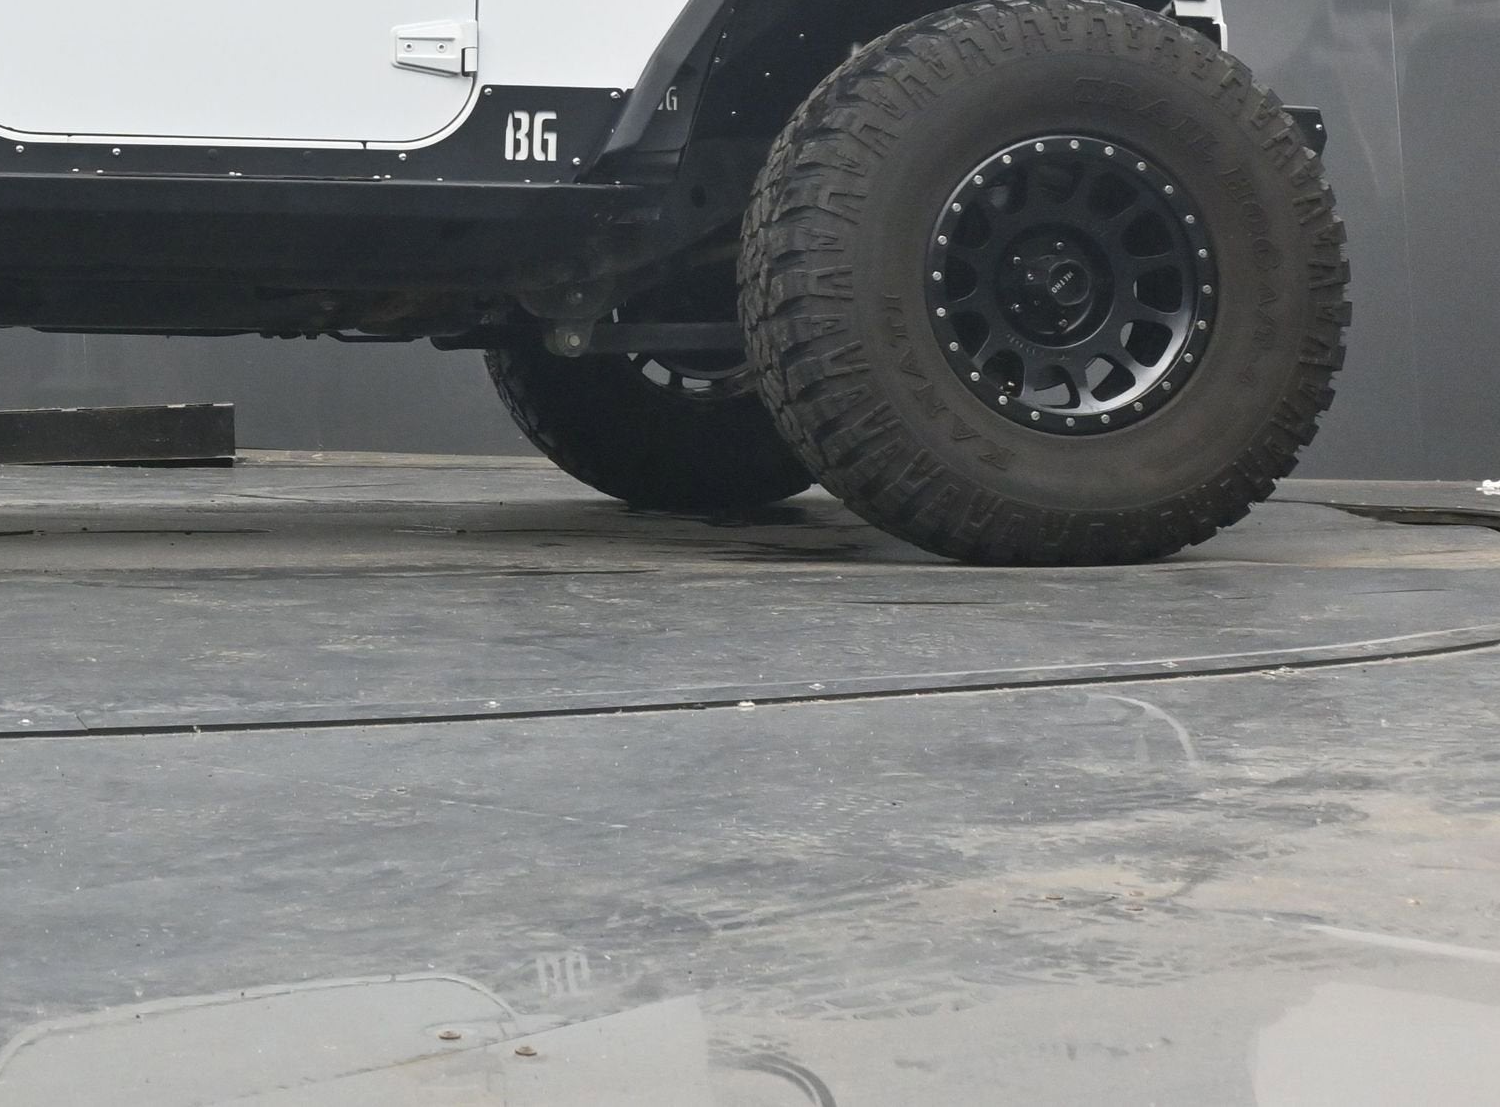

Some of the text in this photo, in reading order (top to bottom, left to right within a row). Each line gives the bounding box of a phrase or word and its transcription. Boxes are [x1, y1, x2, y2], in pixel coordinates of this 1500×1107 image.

[657, 86, 678, 111] G
[1074, 76, 1220, 163] TRAIL
[504, 110, 557, 162] BG
[1051, 270, 1075, 294] METHO
[882, 294, 1016, 471] KANATI
